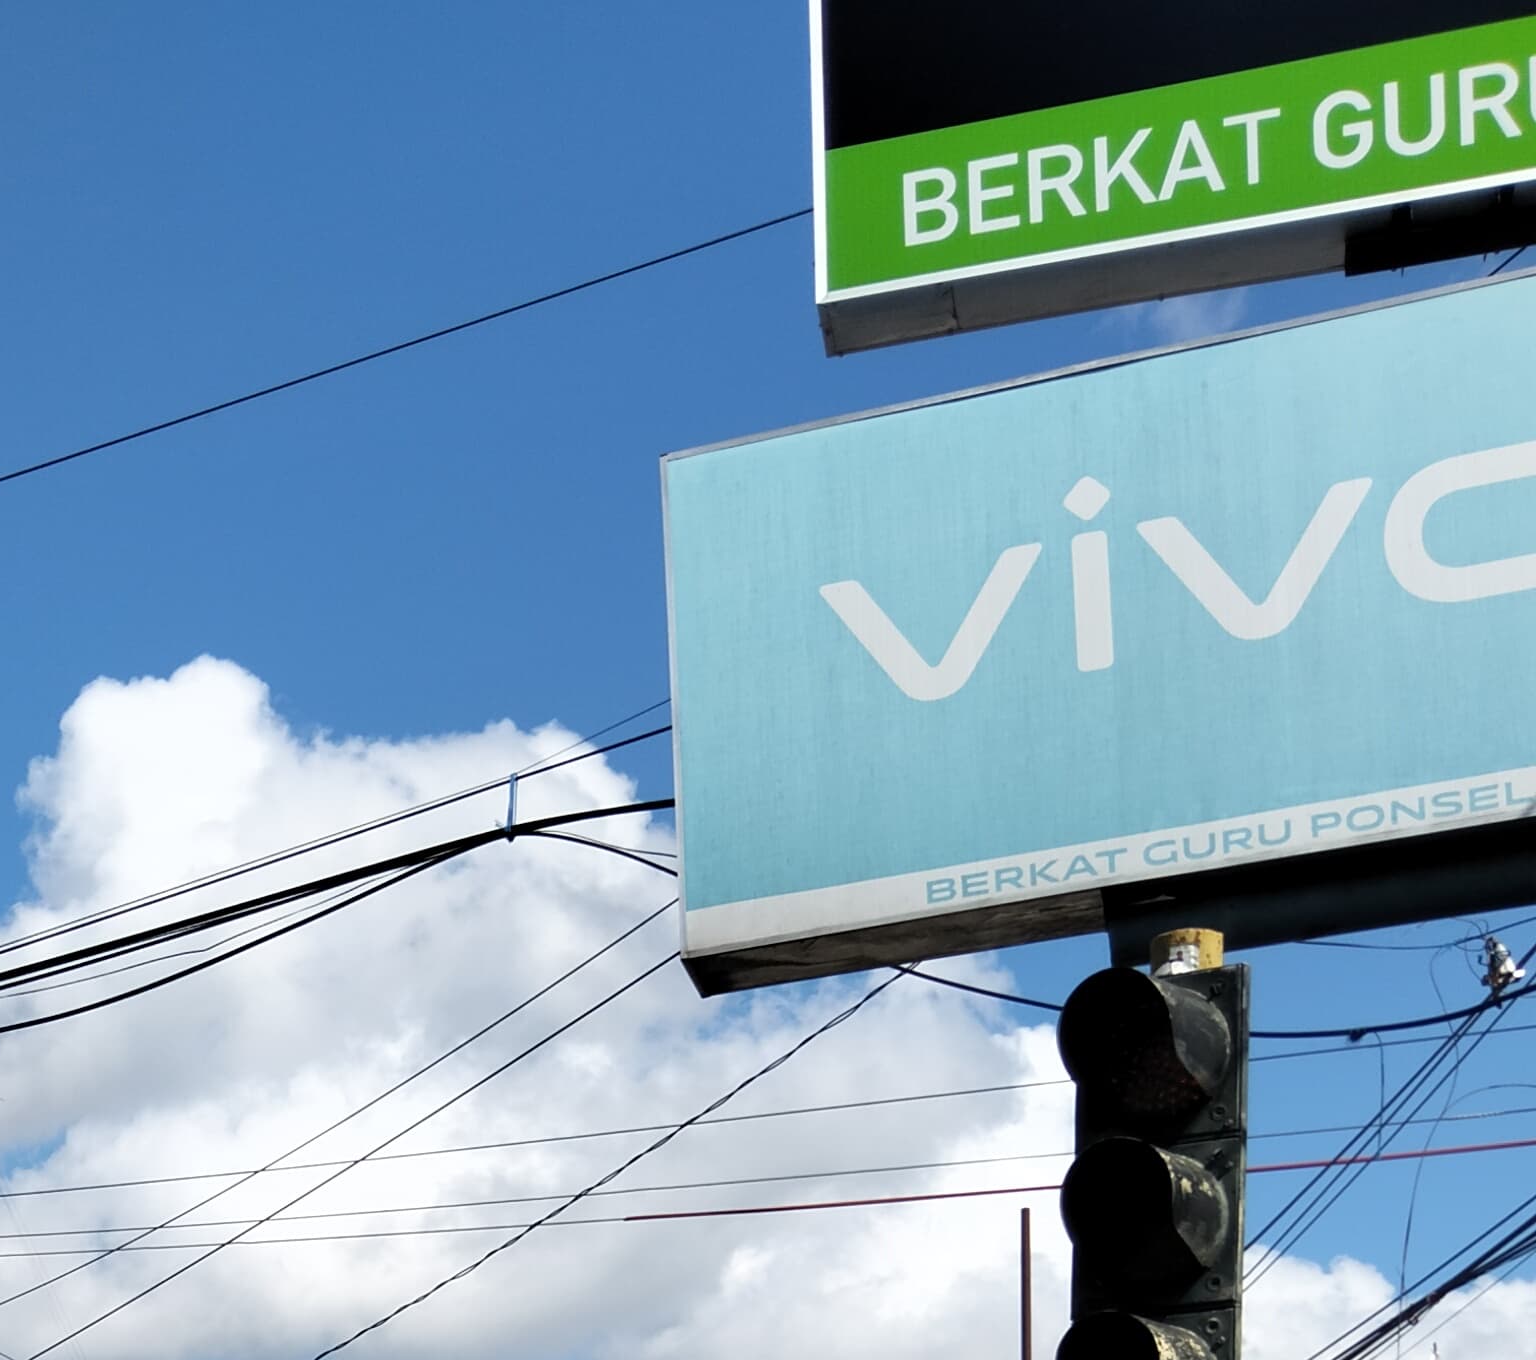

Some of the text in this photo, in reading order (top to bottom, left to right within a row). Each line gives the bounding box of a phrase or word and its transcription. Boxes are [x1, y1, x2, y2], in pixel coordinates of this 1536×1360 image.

[901, 55, 1536, 248] BERKAT GUR
[925, 782, 1536, 905] BERKAT GURU PONSEL
